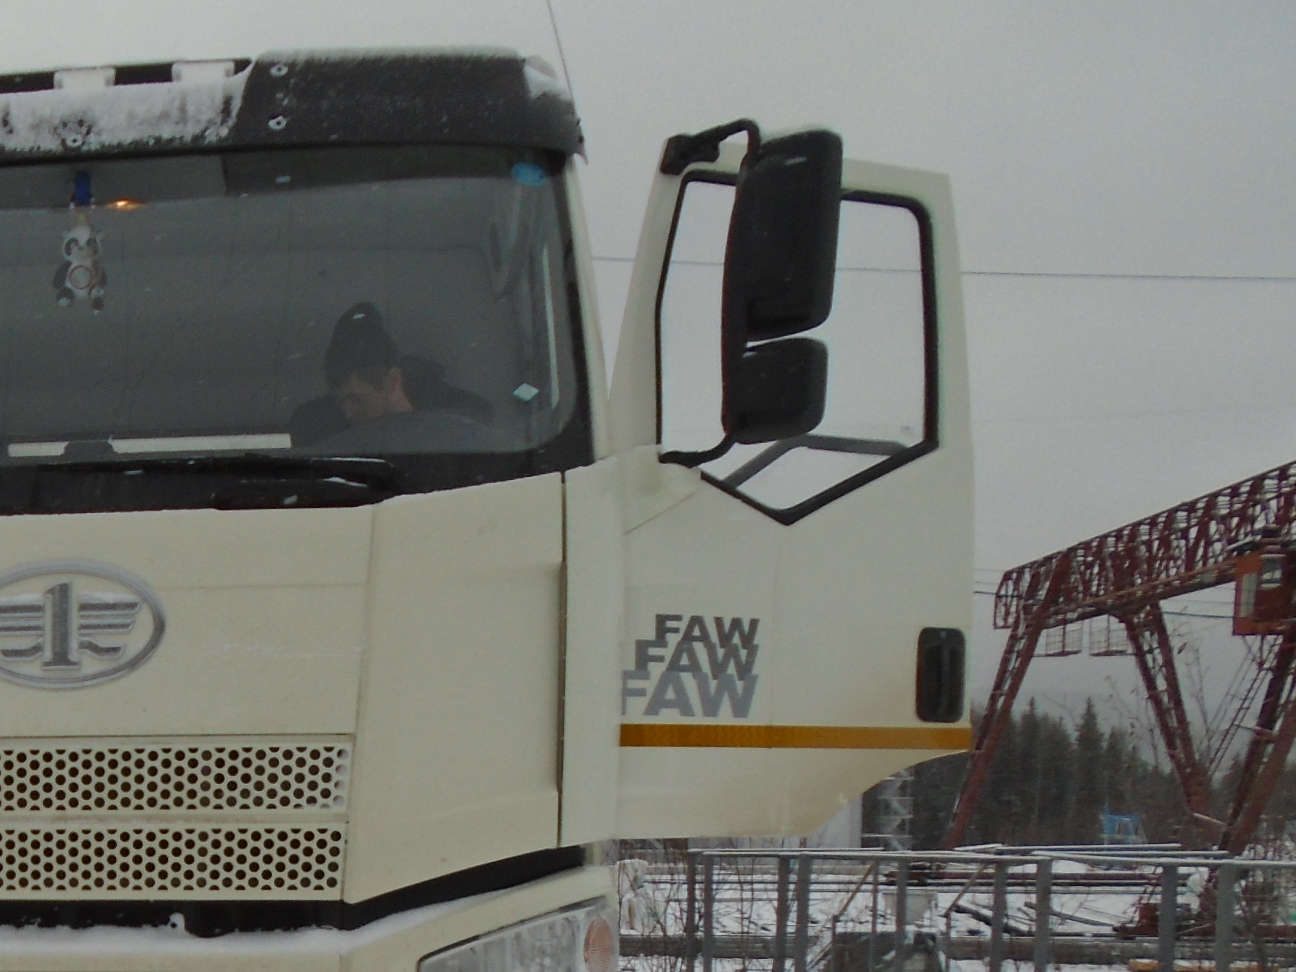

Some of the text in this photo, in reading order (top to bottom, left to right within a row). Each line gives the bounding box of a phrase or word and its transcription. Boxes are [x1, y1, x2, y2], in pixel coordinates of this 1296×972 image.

[655, 613, 760, 650] FAW
[635, 639, 760, 681] FAW
[621, 669, 759, 718] FAW
